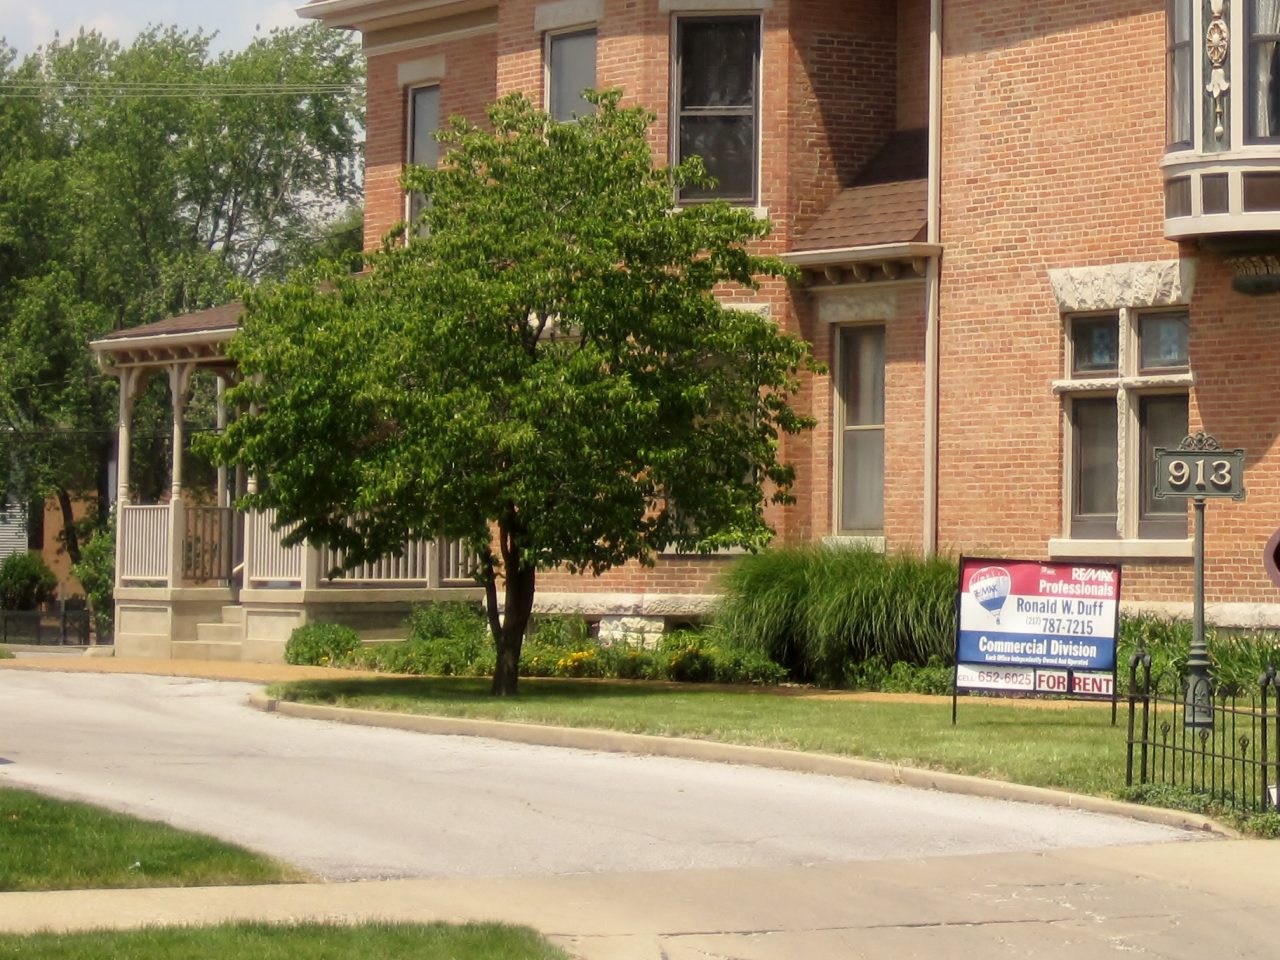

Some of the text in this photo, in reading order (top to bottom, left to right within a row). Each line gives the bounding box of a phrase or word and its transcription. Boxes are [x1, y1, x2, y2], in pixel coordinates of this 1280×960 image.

[1167, 459, 1232, 486] 913
[1072, 568, 1114, 581] RE/MAX
[1039, 579, 1114, 597] Professionals
[1016, 598, 1104, 617] Ronald W. Duff
[1042, 617, 1094, 635] 787-7215
[979, 636, 1097, 658] Commercial Division
[978, 671, 1032, 686] 652-6025
[1037, 674, 1113, 693] FOR RENT
